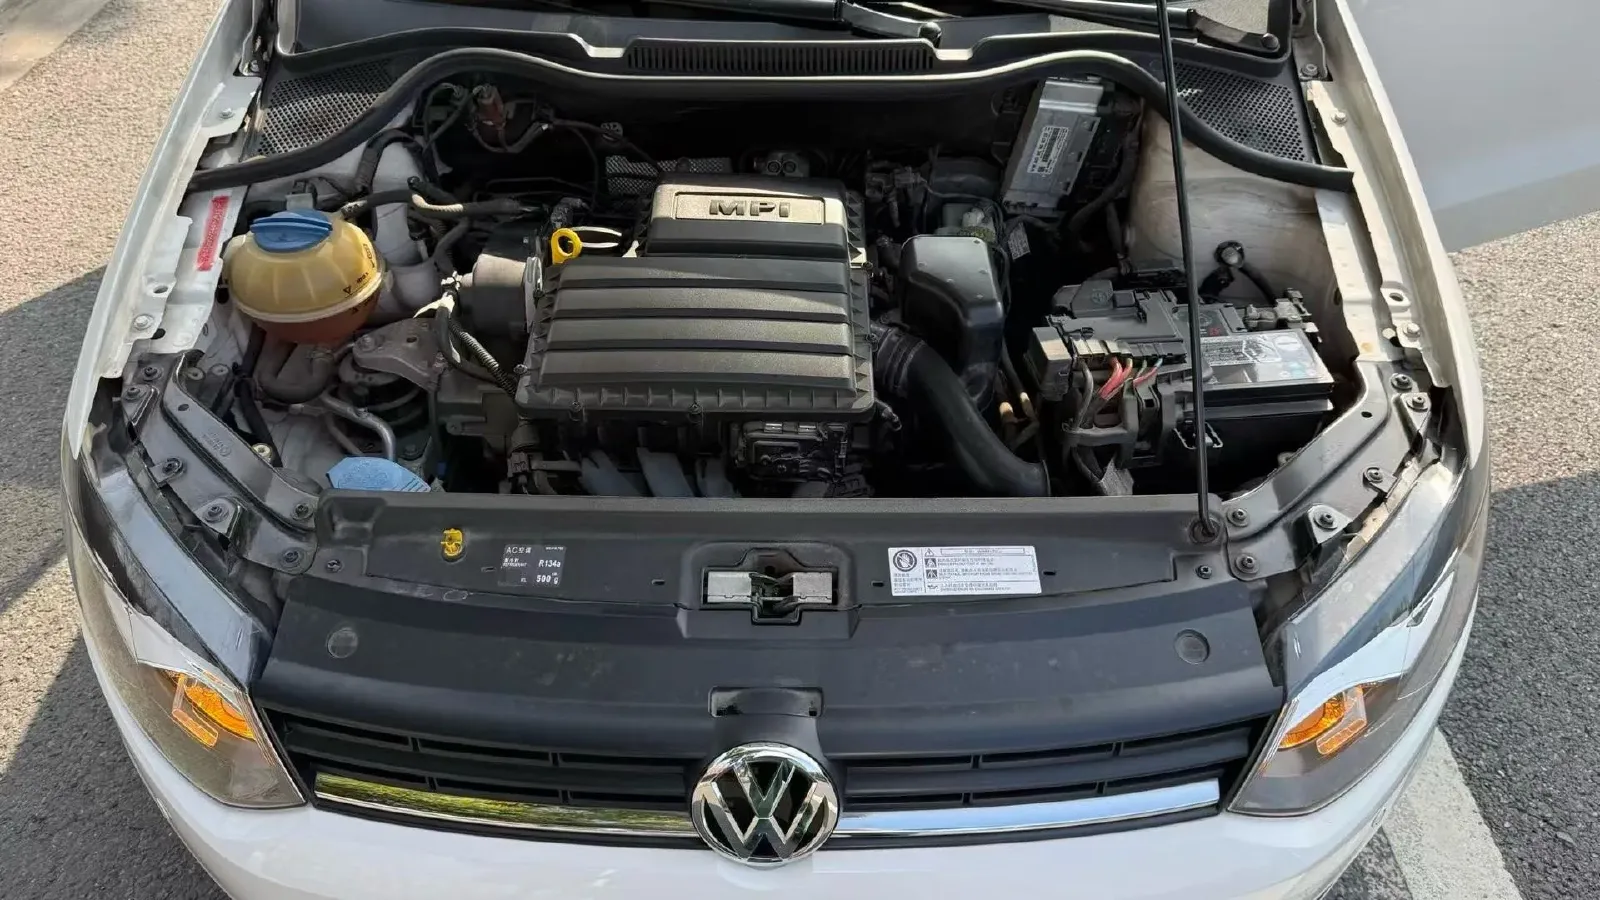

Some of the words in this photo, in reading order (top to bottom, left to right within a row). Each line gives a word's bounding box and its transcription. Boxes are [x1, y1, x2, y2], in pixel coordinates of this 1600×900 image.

[709, 199, 790, 218] MPI
[538, 559, 561, 568] R134a
[536, 575, 551, 583] 500
[695, 750, 835, 863] VW
